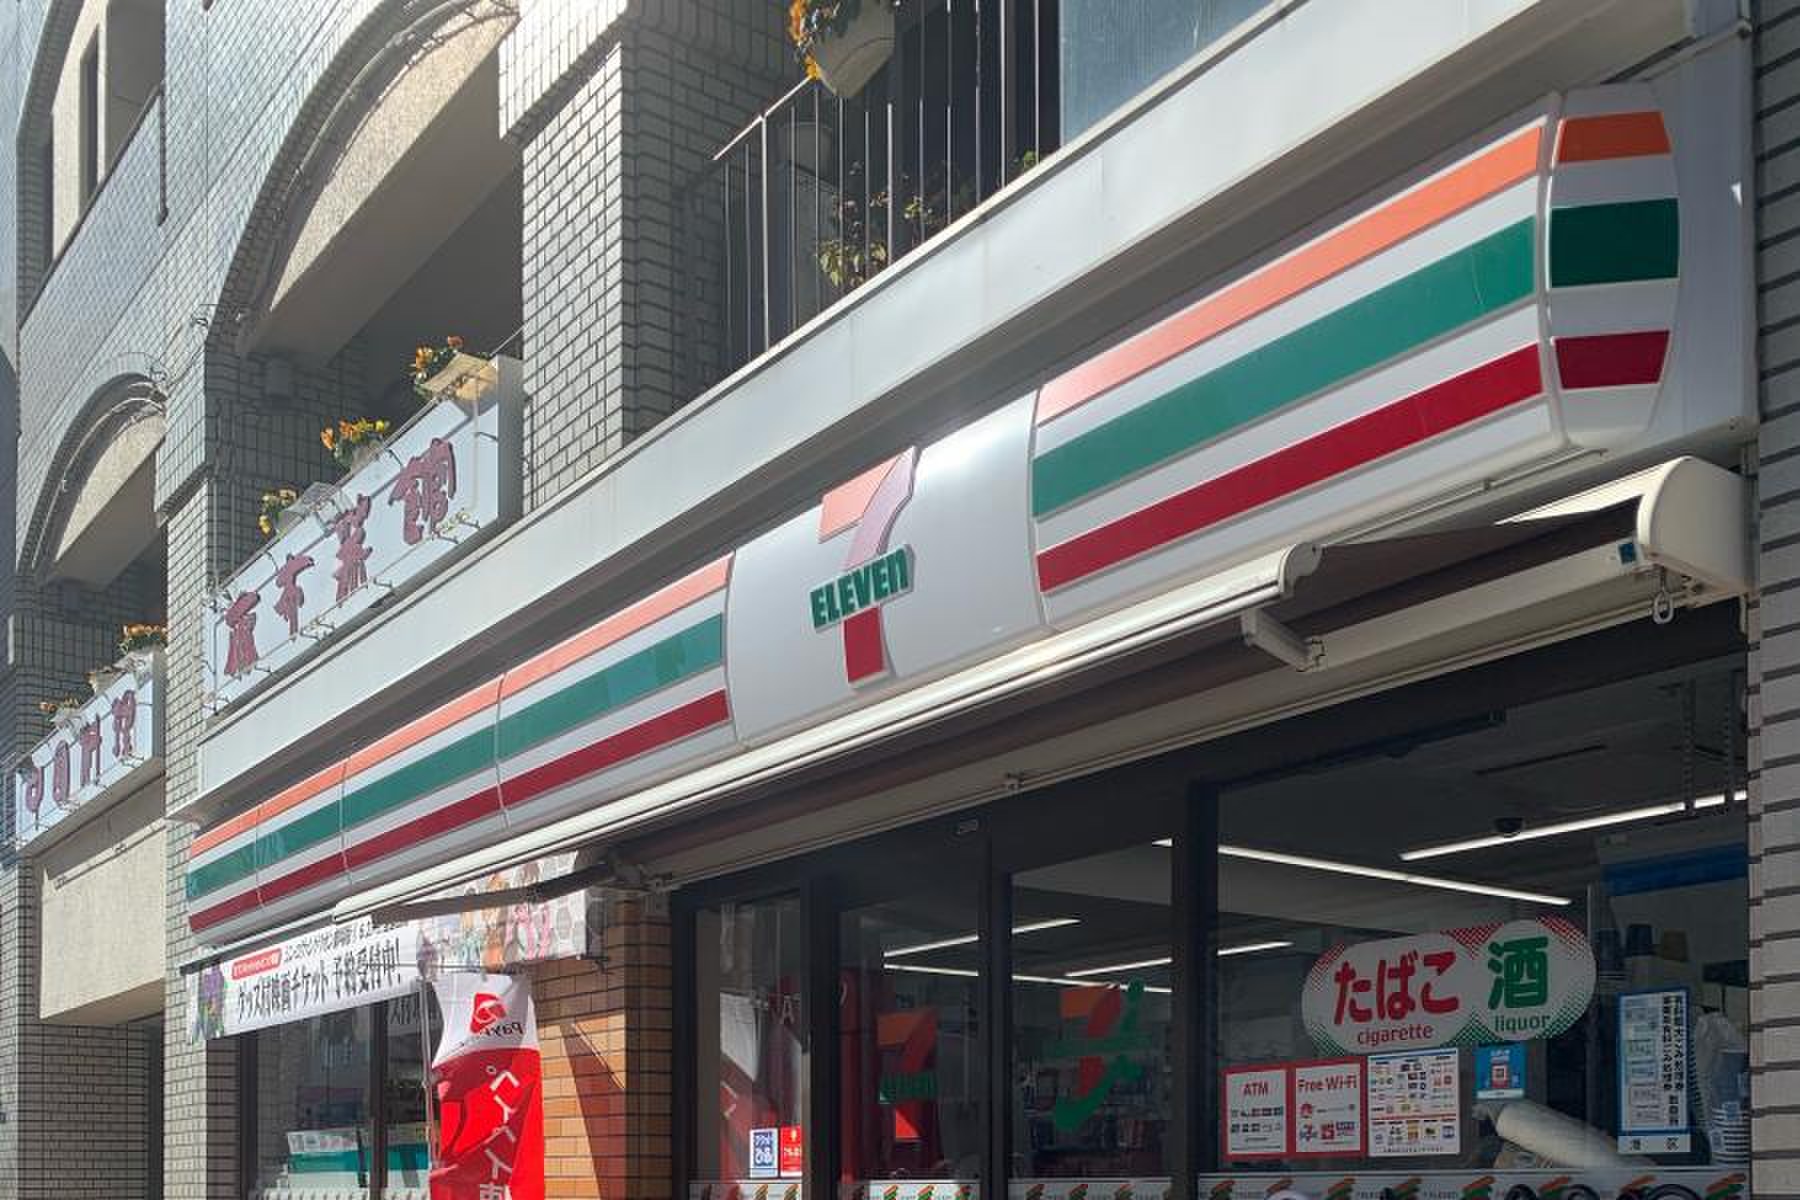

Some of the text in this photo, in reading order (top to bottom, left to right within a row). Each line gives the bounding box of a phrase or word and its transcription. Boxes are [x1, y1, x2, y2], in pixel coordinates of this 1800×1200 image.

[1487, 935, 1550, 1010] 酒
[1334, 949, 1460, 1026] たばこ
[1357, 1022, 1435, 1048] cigarette
[1494, 1013, 1551, 1034] liquor
[1243, 1080, 1269, 1097] ATM
[1297, 1077, 1324, 1094] Free
